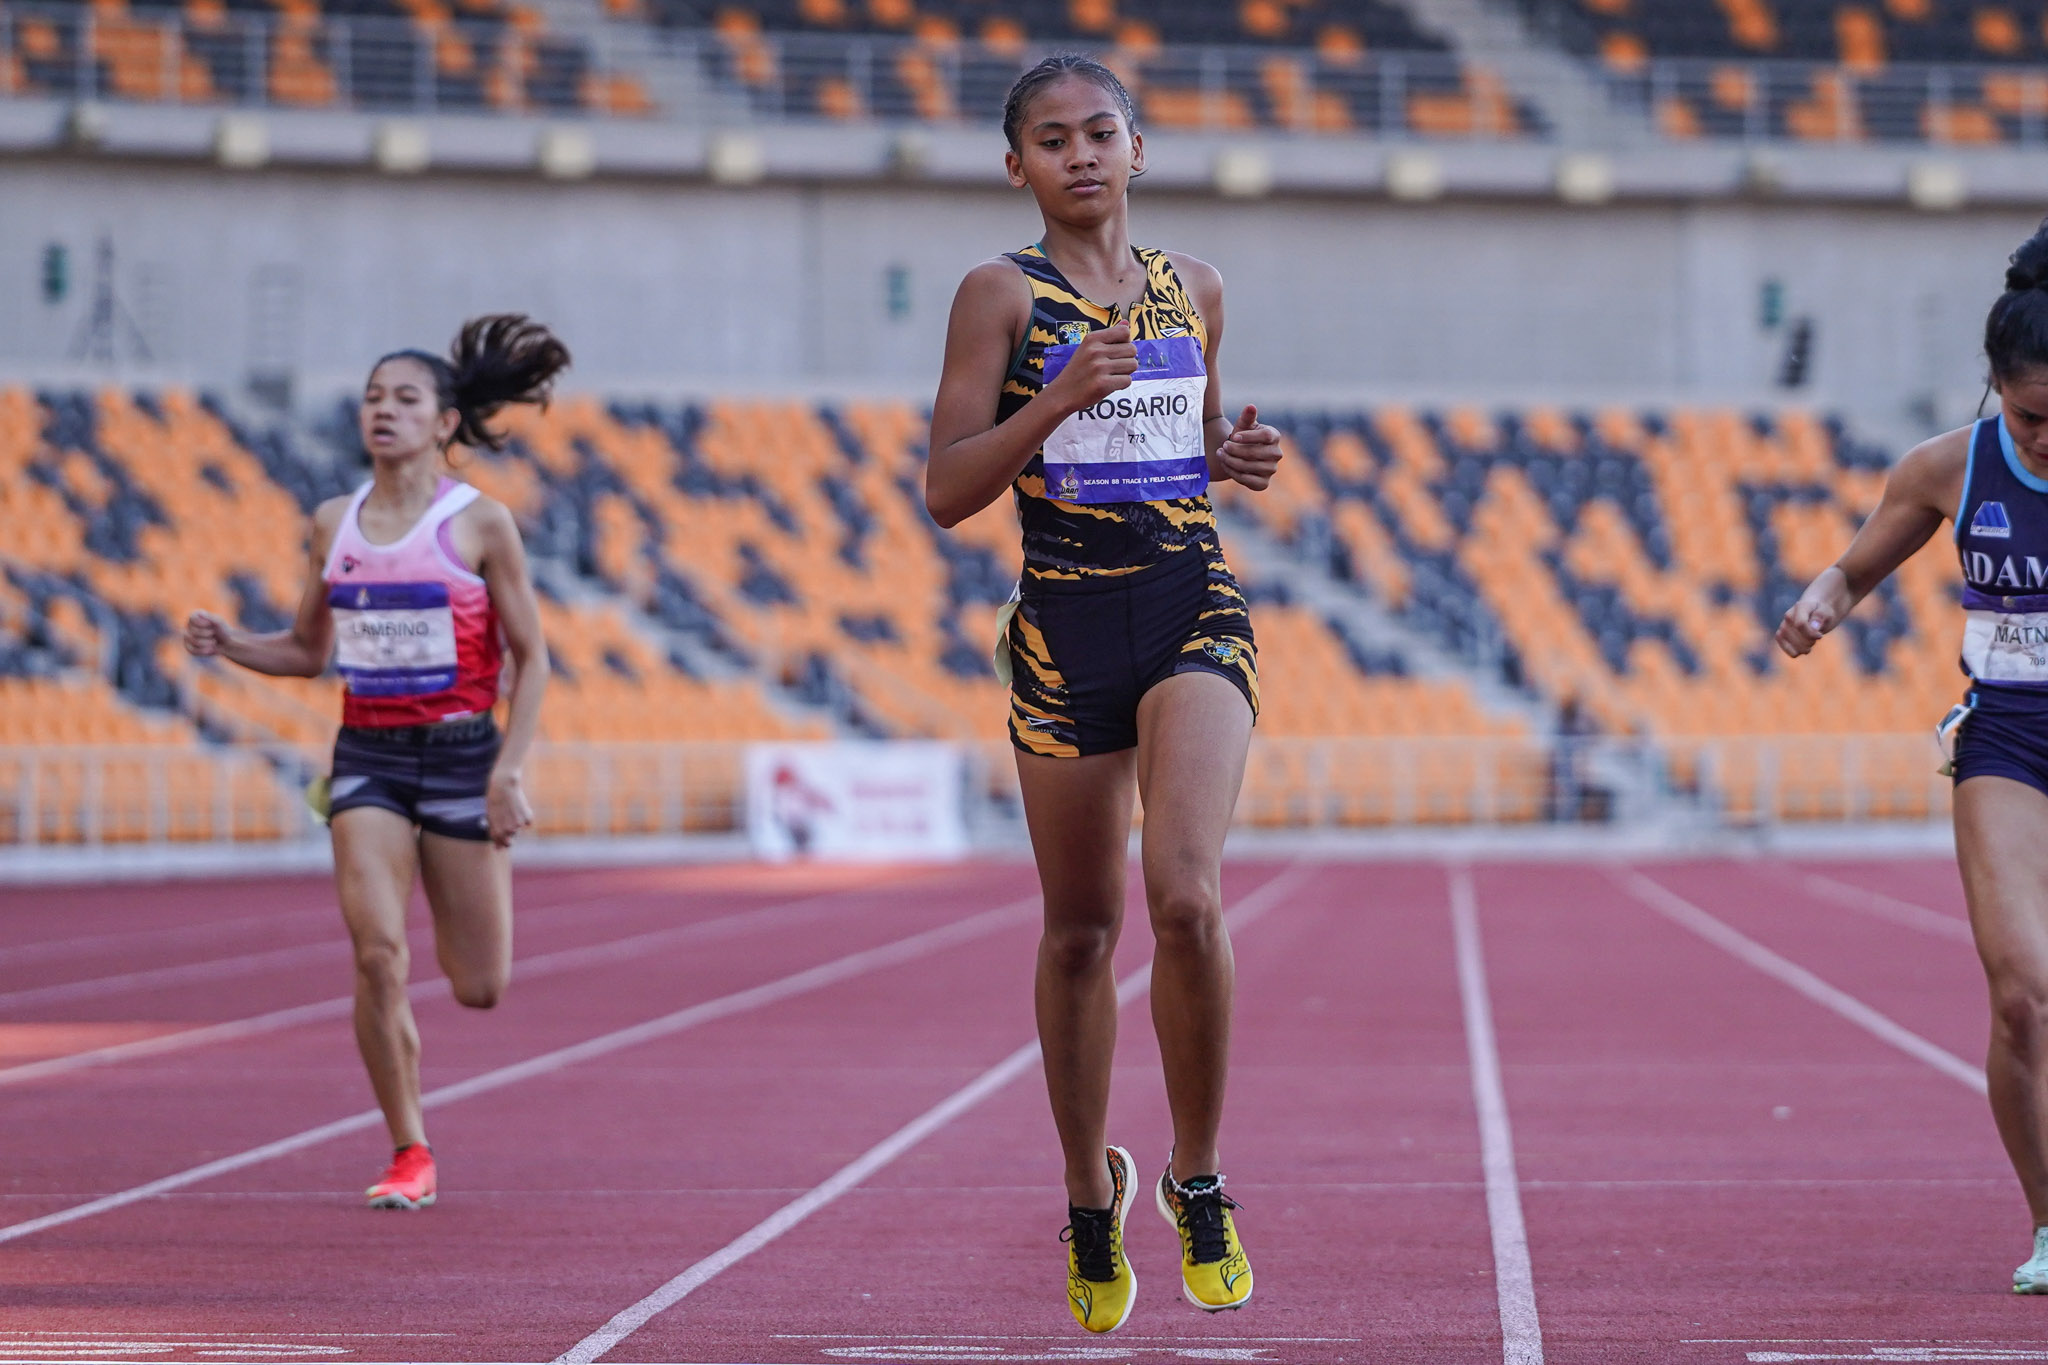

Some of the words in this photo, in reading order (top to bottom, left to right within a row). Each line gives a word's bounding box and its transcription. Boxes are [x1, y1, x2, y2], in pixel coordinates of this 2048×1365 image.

[1078, 394, 1188, 420] ROSARIO
[1127, 433, 1146, 443] 773
[353, 621, 429, 636] LAMBINO
[1994, 625, 2048, 643] MATN
[2029, 656, 2046, 666] 709
